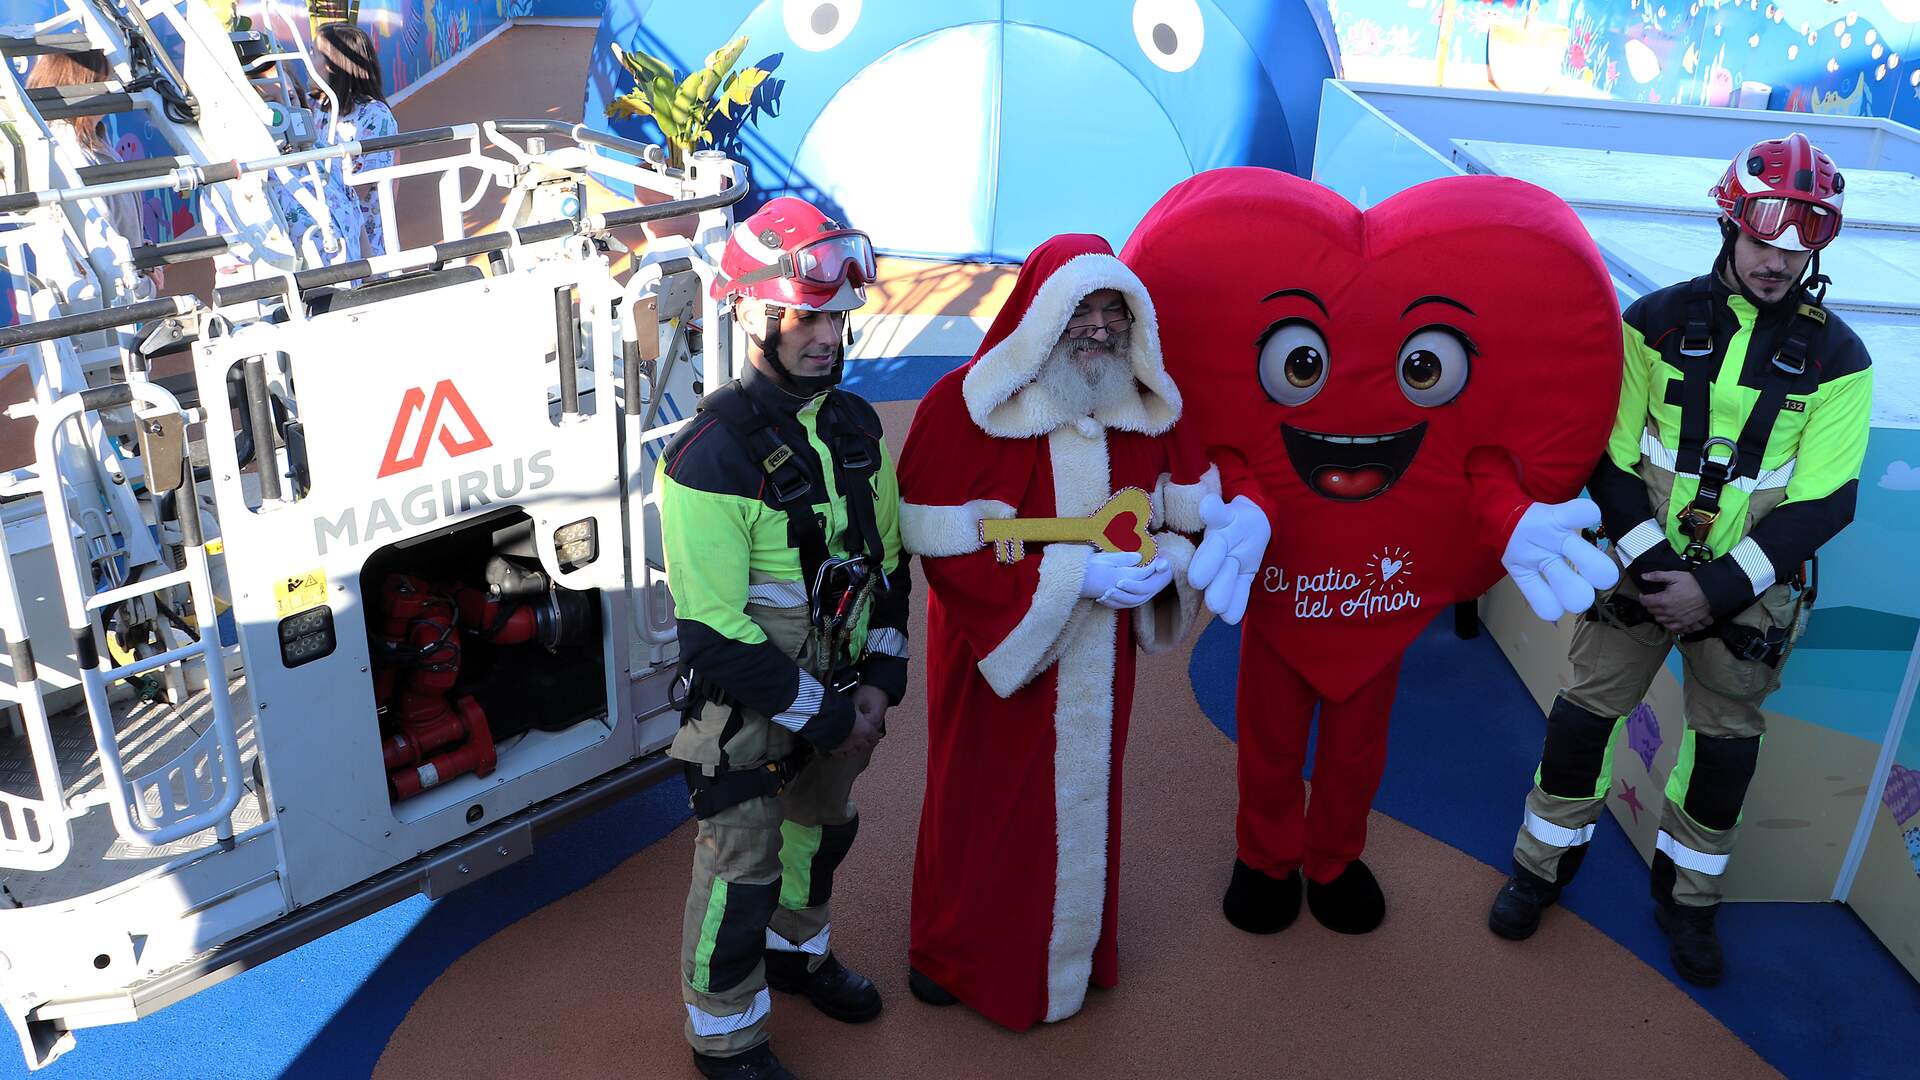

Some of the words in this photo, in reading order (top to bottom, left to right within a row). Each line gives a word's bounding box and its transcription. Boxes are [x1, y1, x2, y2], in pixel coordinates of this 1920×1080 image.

[313, 450, 555, 556] MAGIRUS
[1263, 566, 1290, 593] El
[1295, 567, 1361, 601] patio
[1295, 595, 1333, 618] del
[1340, 588, 1420, 619] Amor
